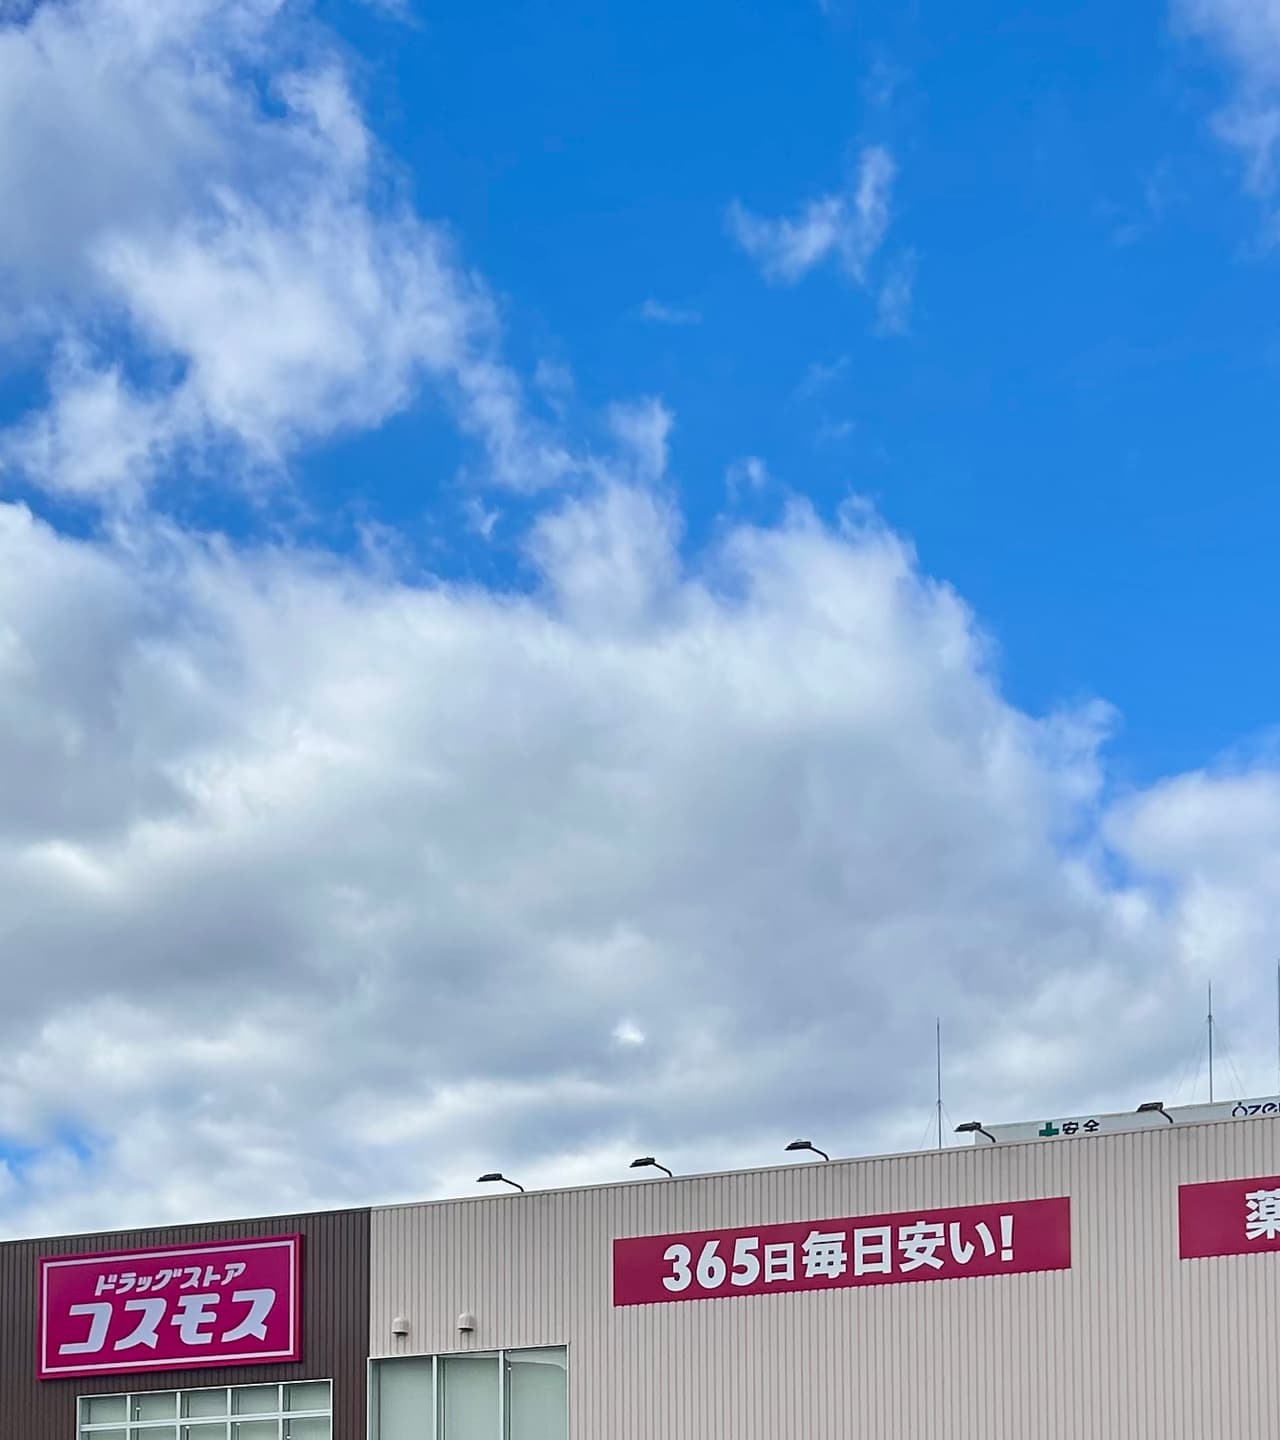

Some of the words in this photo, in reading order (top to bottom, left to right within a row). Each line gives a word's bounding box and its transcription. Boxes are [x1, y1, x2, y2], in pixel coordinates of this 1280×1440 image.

[94, 1262, 246, 1296] ドラッグストア
[662, 1215, 1014, 1292] 365日毎日安い!
[58, 1288, 276, 1355] コスモス
